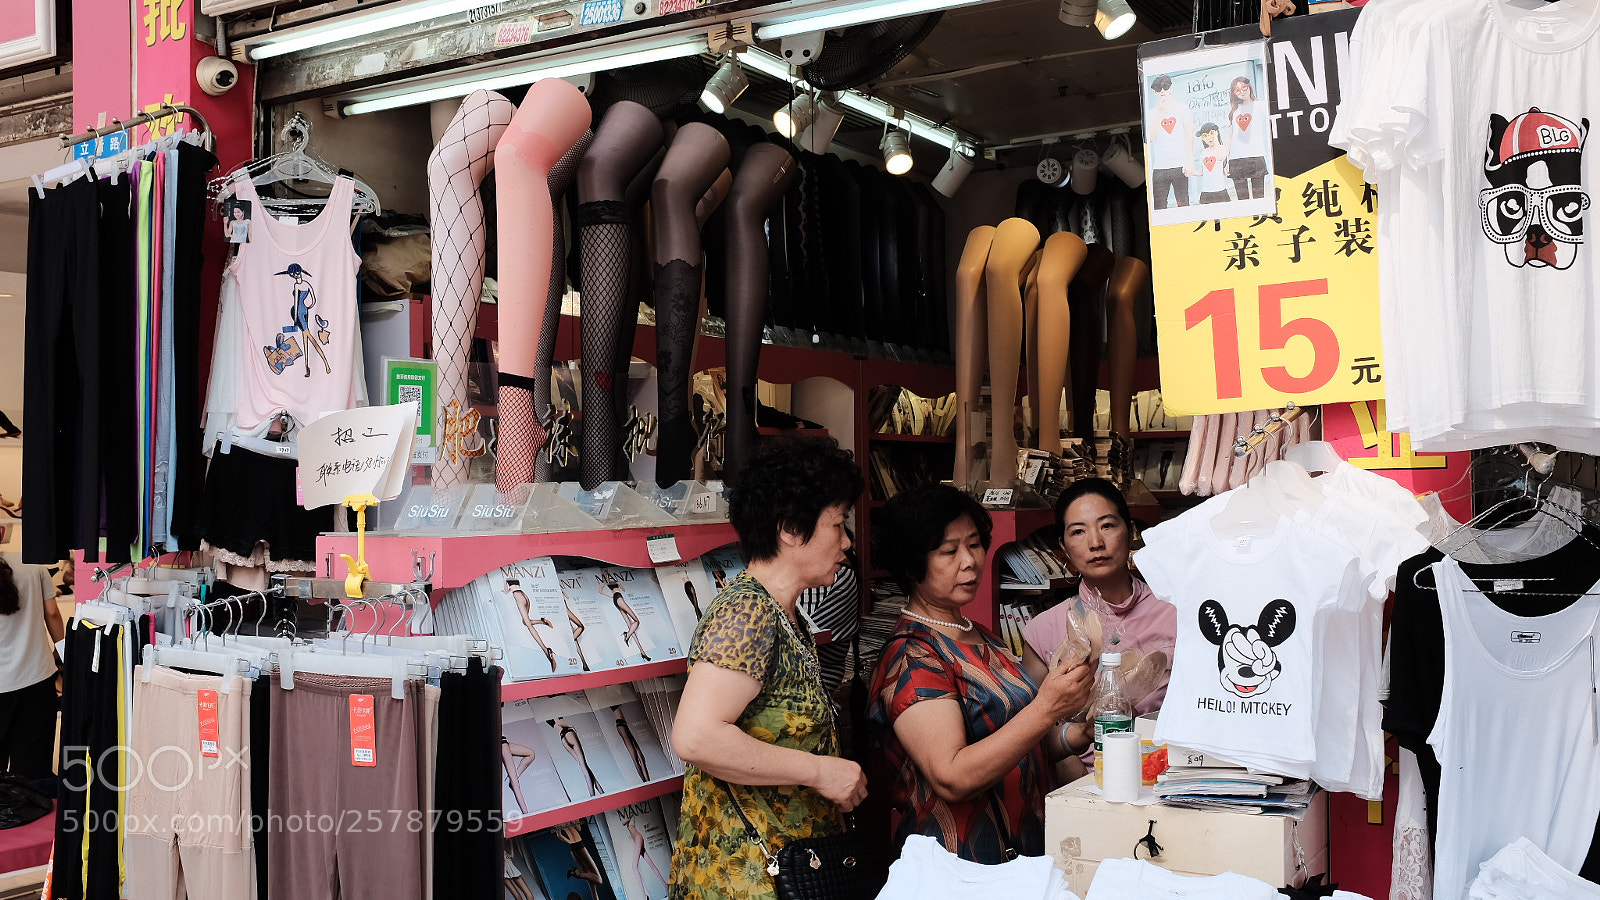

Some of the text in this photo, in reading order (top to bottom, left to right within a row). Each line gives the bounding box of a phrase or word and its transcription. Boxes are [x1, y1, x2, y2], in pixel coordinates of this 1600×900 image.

[1540, 127, 1570, 145] BLG
[79, 136, 120, 156] 立路
[1223, 217, 1375, 272] 亲子装
[1184, 278, 1340, 400] 15
[1350, 356, 1382, 386] 元
[408, 504, 450, 519] SiuSiu
[472, 504, 514, 519] SiuSiu
[704, 559, 735, 569] MANZI
[500, 566, 546, 579] MANZI
[594, 570, 635, 585] MANZI
[559, 578, 582, 590] NZI
[617, 800, 653, 821] MANZI
